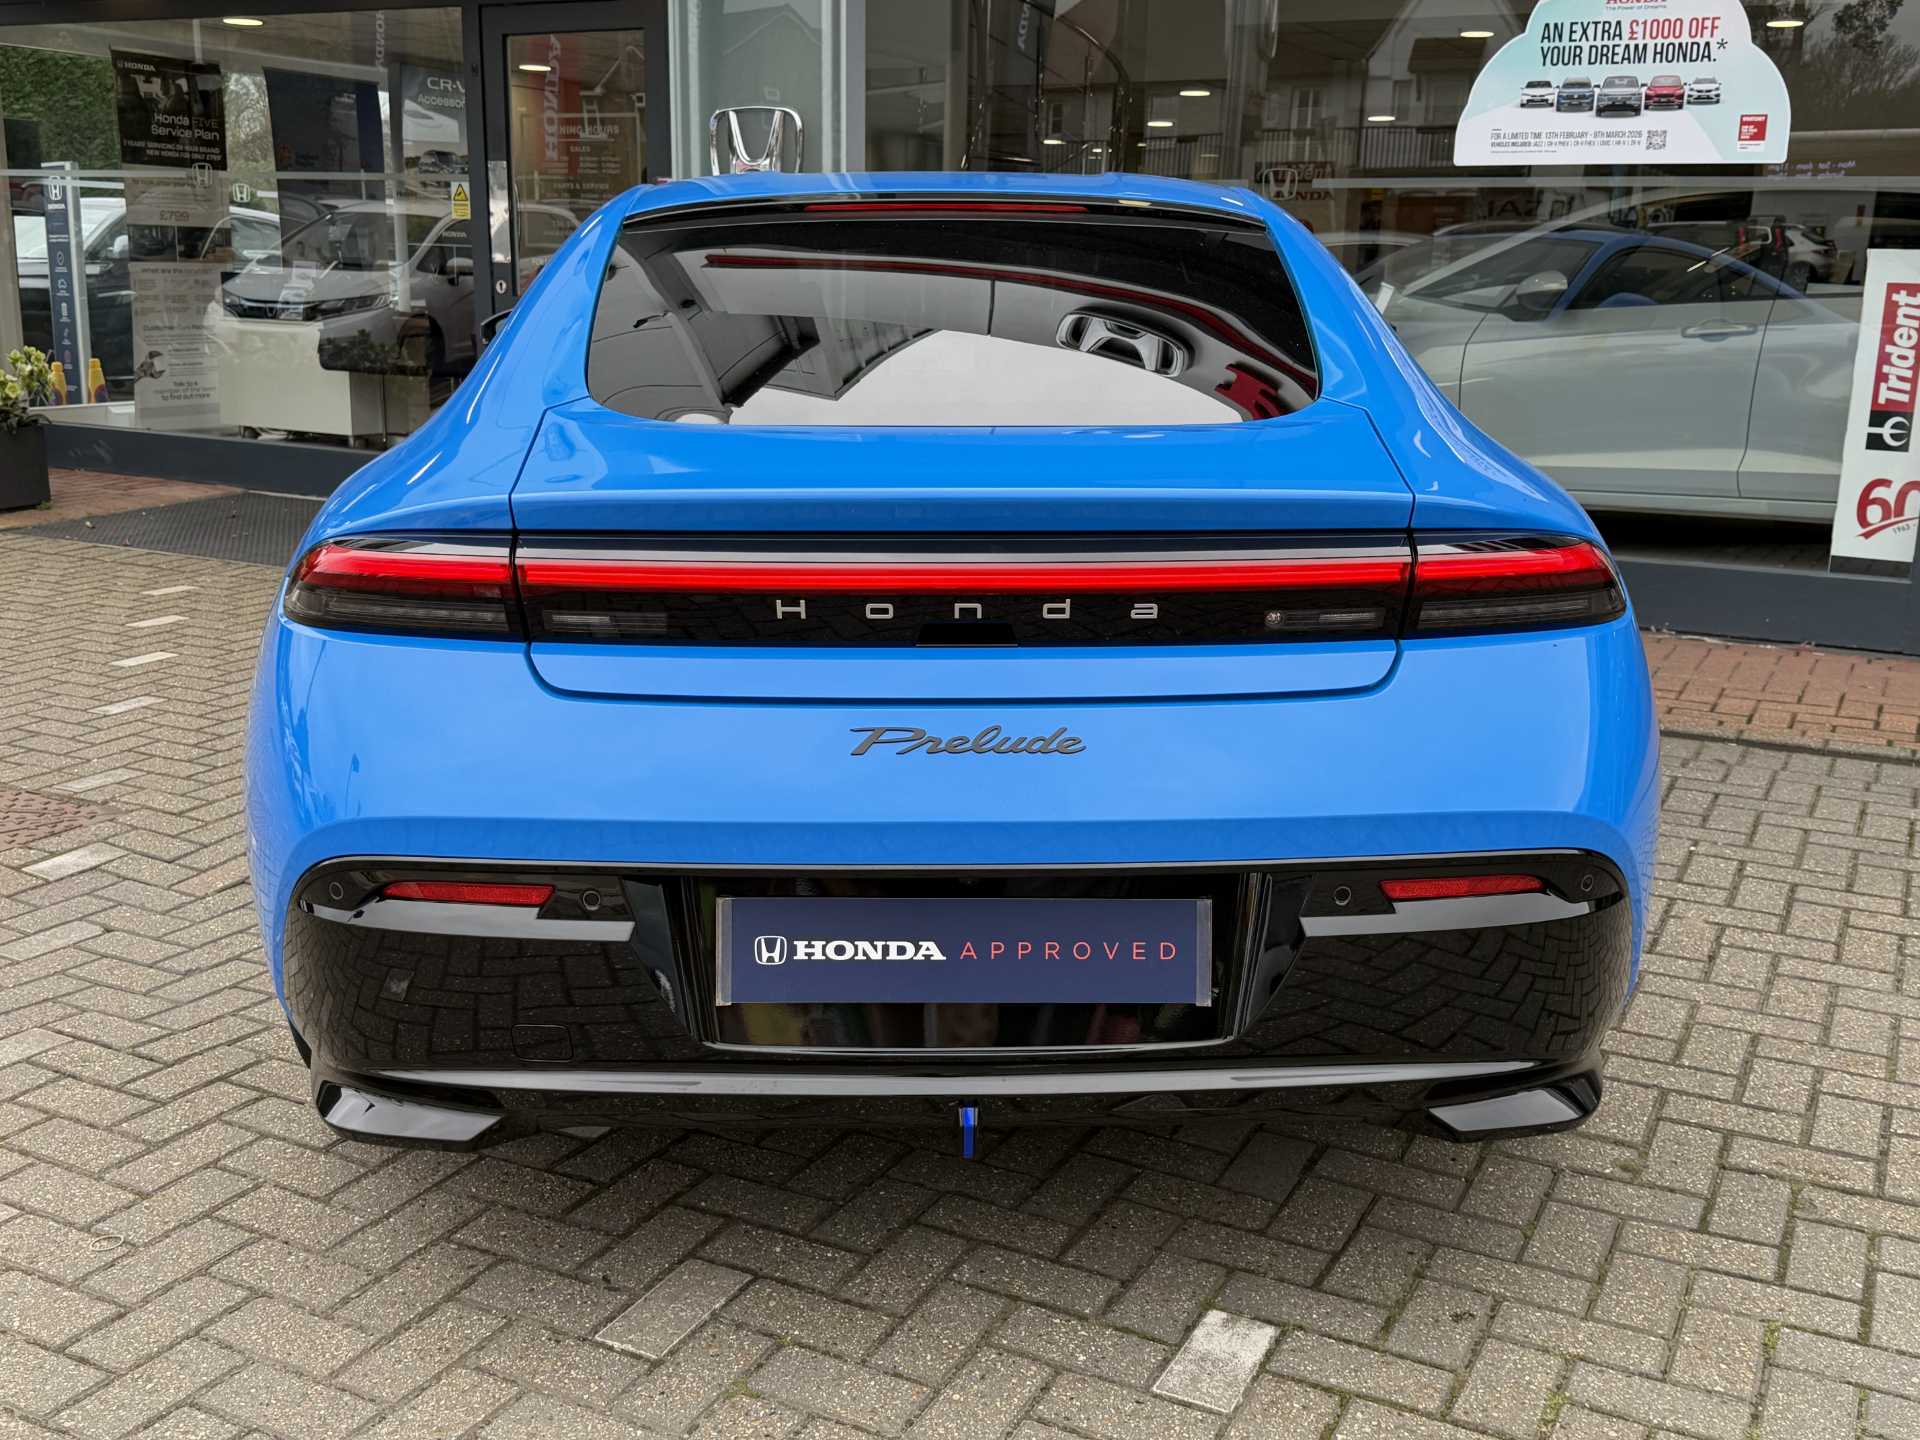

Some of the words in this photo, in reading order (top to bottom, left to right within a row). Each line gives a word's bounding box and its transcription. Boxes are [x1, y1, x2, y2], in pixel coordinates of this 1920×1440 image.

[1541, 22, 1564, 43] AN
[1568, 20, 1623, 43] EXTRA
[1628, 17, 1684, 41] £1000
[1688, 16, 1721, 39] OFF
[1541, 45, 1583, 66] YOUR
[1588, 43, 1648, 65] DREAM
[124, 61, 157, 72] HONDA
[154, 111, 190, 127] Honda
[151, 124, 193, 138] Service
[193, 128, 220, 140] Plan
[1490, 132, 1501, 140] FOR
[1559, 131, 1588, 139] FEBRUARY
[1605, 130, 1626, 138] MARCH
[1876, 289, 1920, 405] Trident
[776, 598, 1158, 620] Honda
[849, 724, 1087, 756] Prelude
[793, 940, 947, 961] HONDA
[960, 941, 1177, 961] APPROVED
